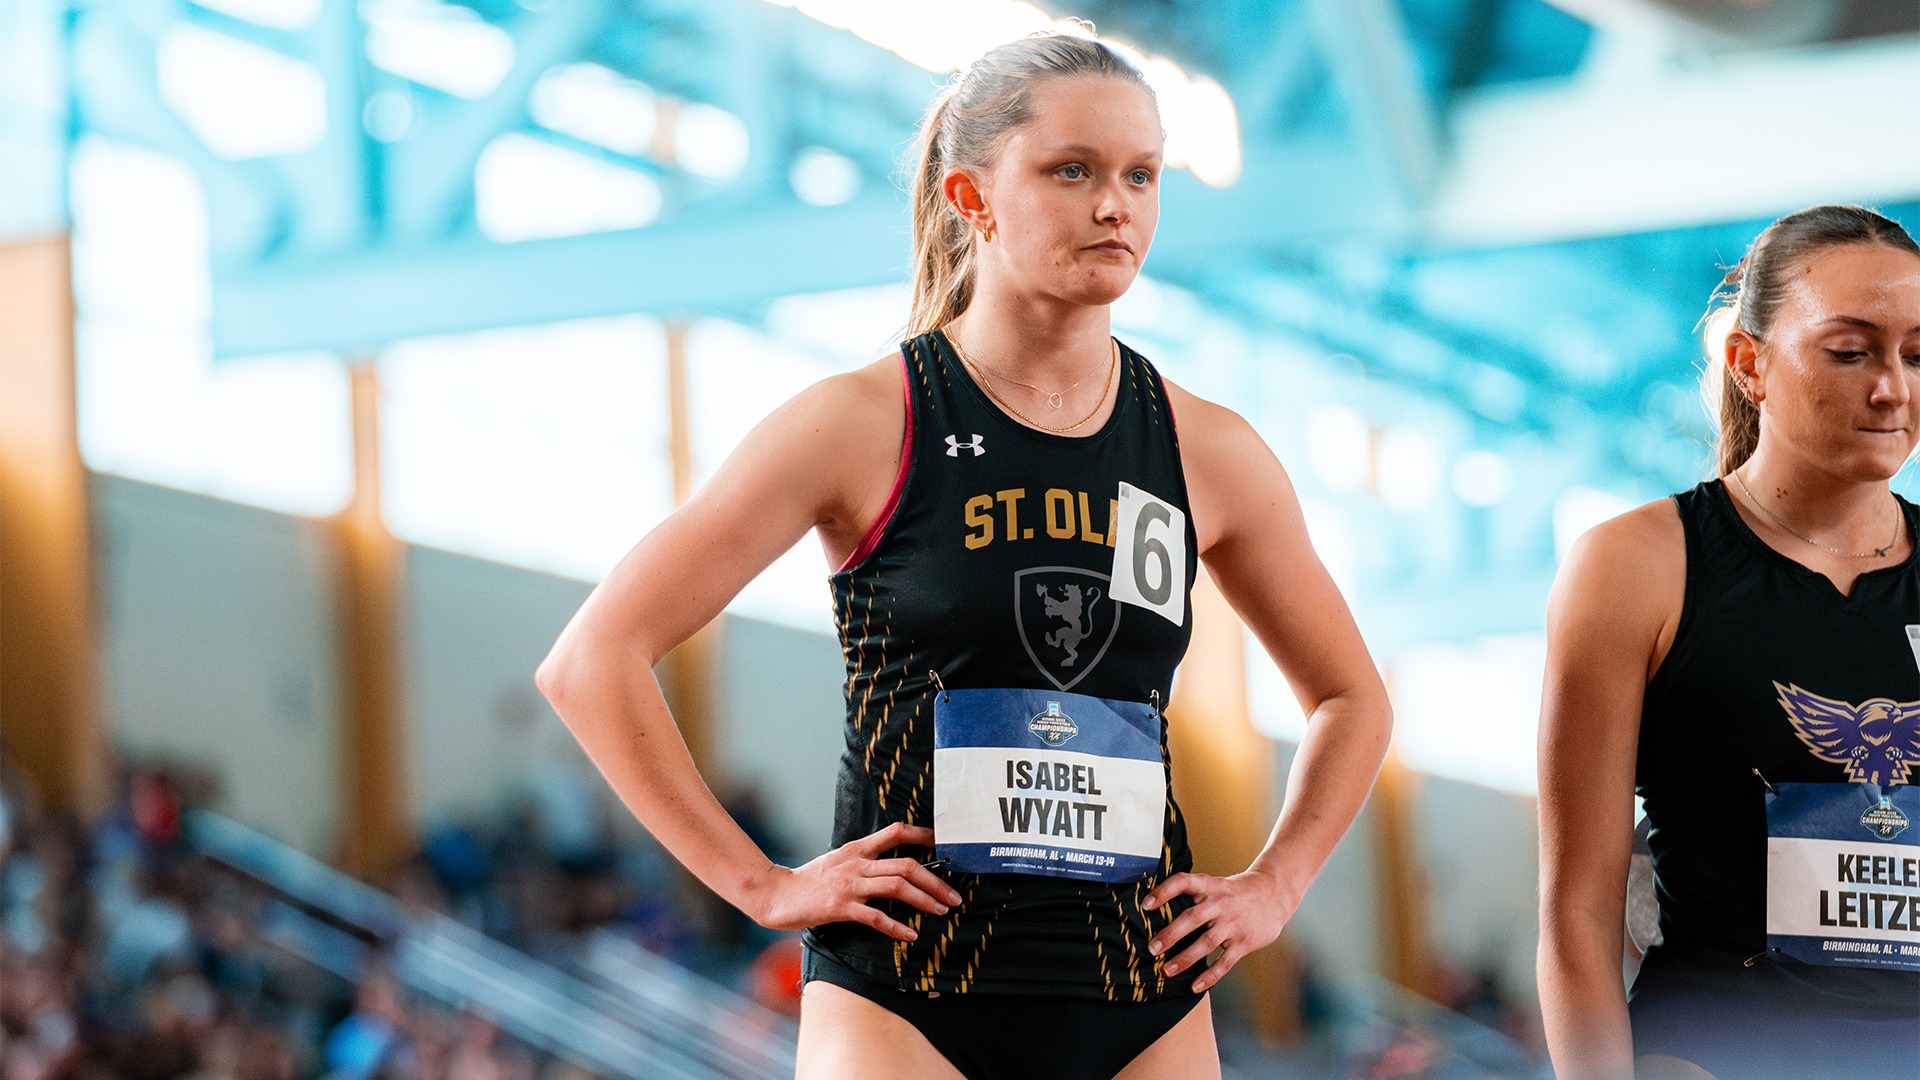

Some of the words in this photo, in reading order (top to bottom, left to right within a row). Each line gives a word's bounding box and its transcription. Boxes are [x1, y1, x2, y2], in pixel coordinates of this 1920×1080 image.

[965, 487, 1034, 550] ST.
[1132, 501, 1172, 606] 6
[1030, 723, 1077, 734] CHAMPIONSHIPS
[1006, 760, 1102, 796] ISABEL
[998, 796, 1108, 841] WYATT
[1862, 816, 1908, 827] CHAMPIONSHIPS
[989, 846, 1048, 860] BIRMINGHAM,
[1049, 850, 1059, 860] AL
[1065, 852, 1095, 865] MARCH
[1095, 856, 1116, 867] 13-14
[1837, 853, 1920, 889] KEELE
[1822, 940, 1881, 954] BIRMINGHAM,
[1883, 944, 1893, 954] AL
